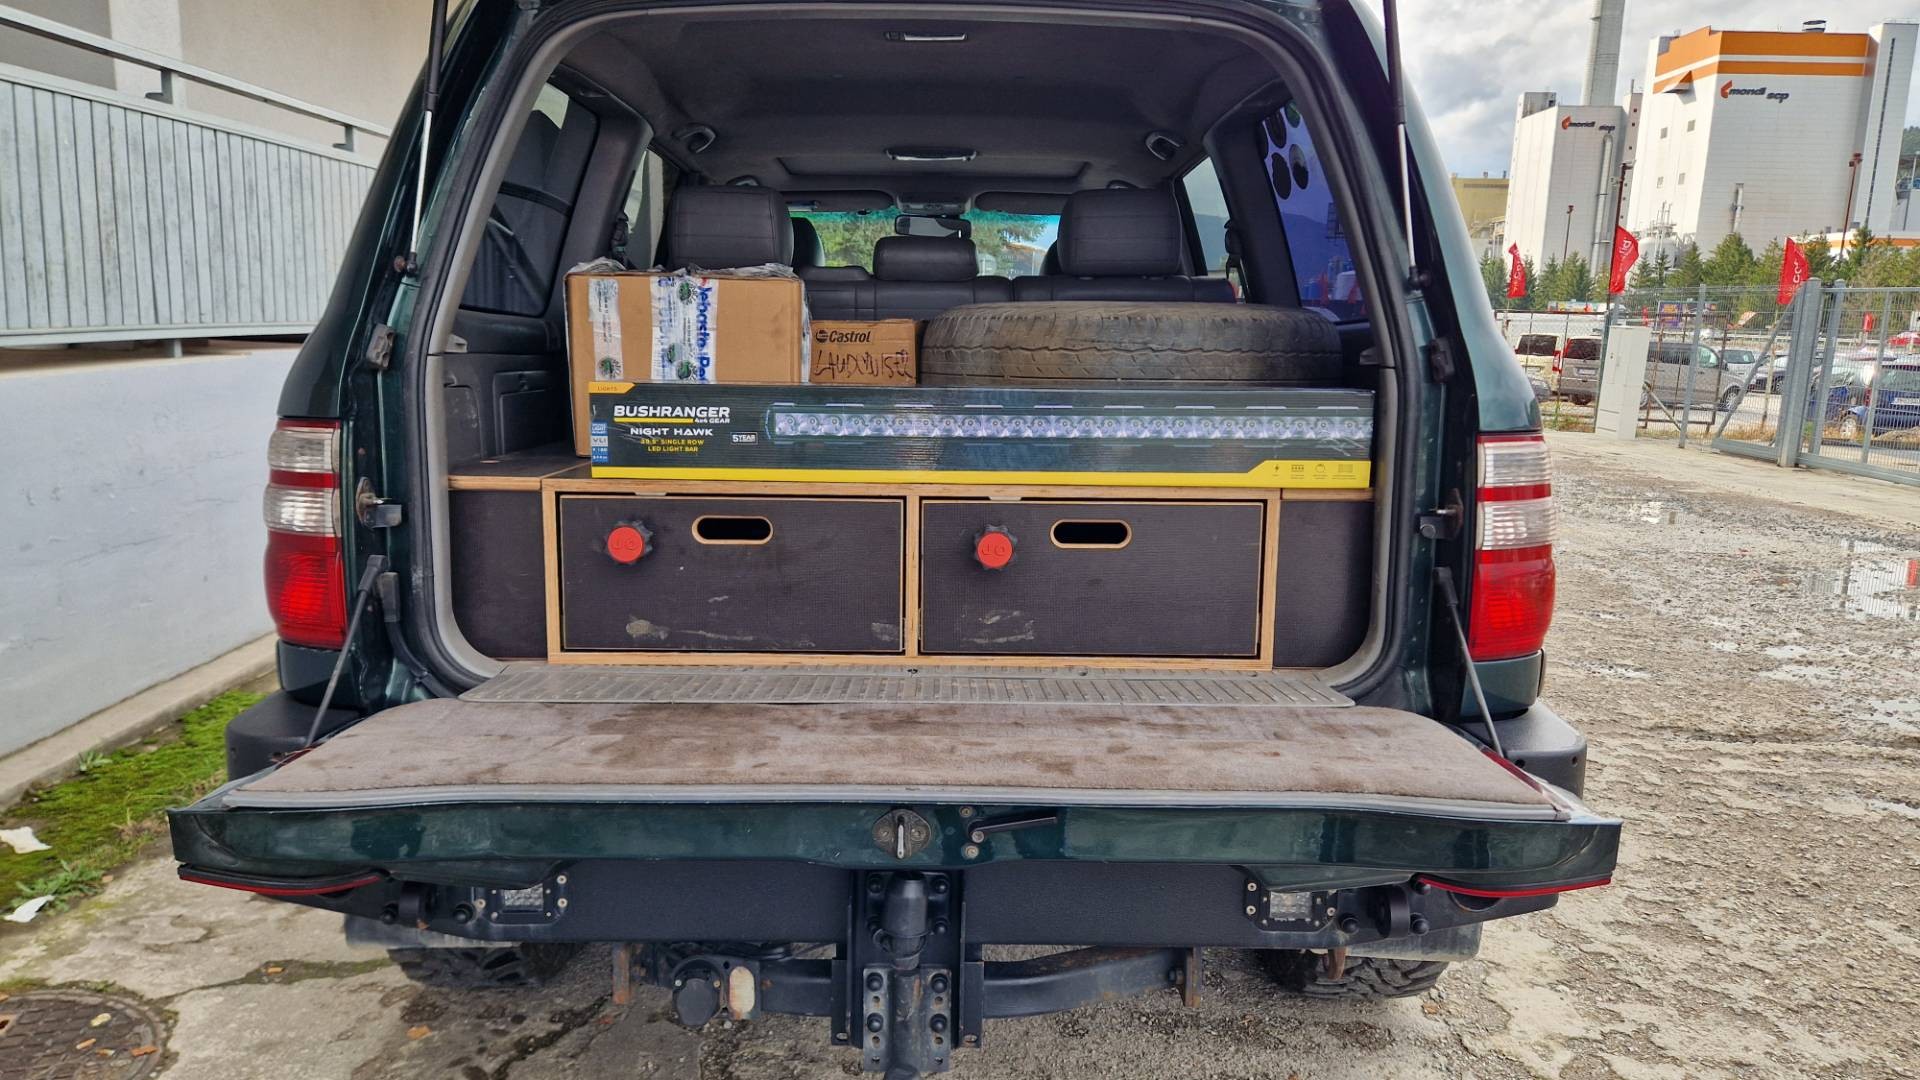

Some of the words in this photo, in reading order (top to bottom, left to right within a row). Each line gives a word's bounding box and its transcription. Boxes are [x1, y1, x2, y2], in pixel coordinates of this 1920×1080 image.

[1728, 87, 1767, 96] mondi
[1766, 92, 1790, 104] scp
[829, 330, 872, 343] Castrol
[613, 405, 731, 418] BUSHRANGER
[630, 427, 670, 436] NIGHT
[673, 428, 714, 437] HAWK
